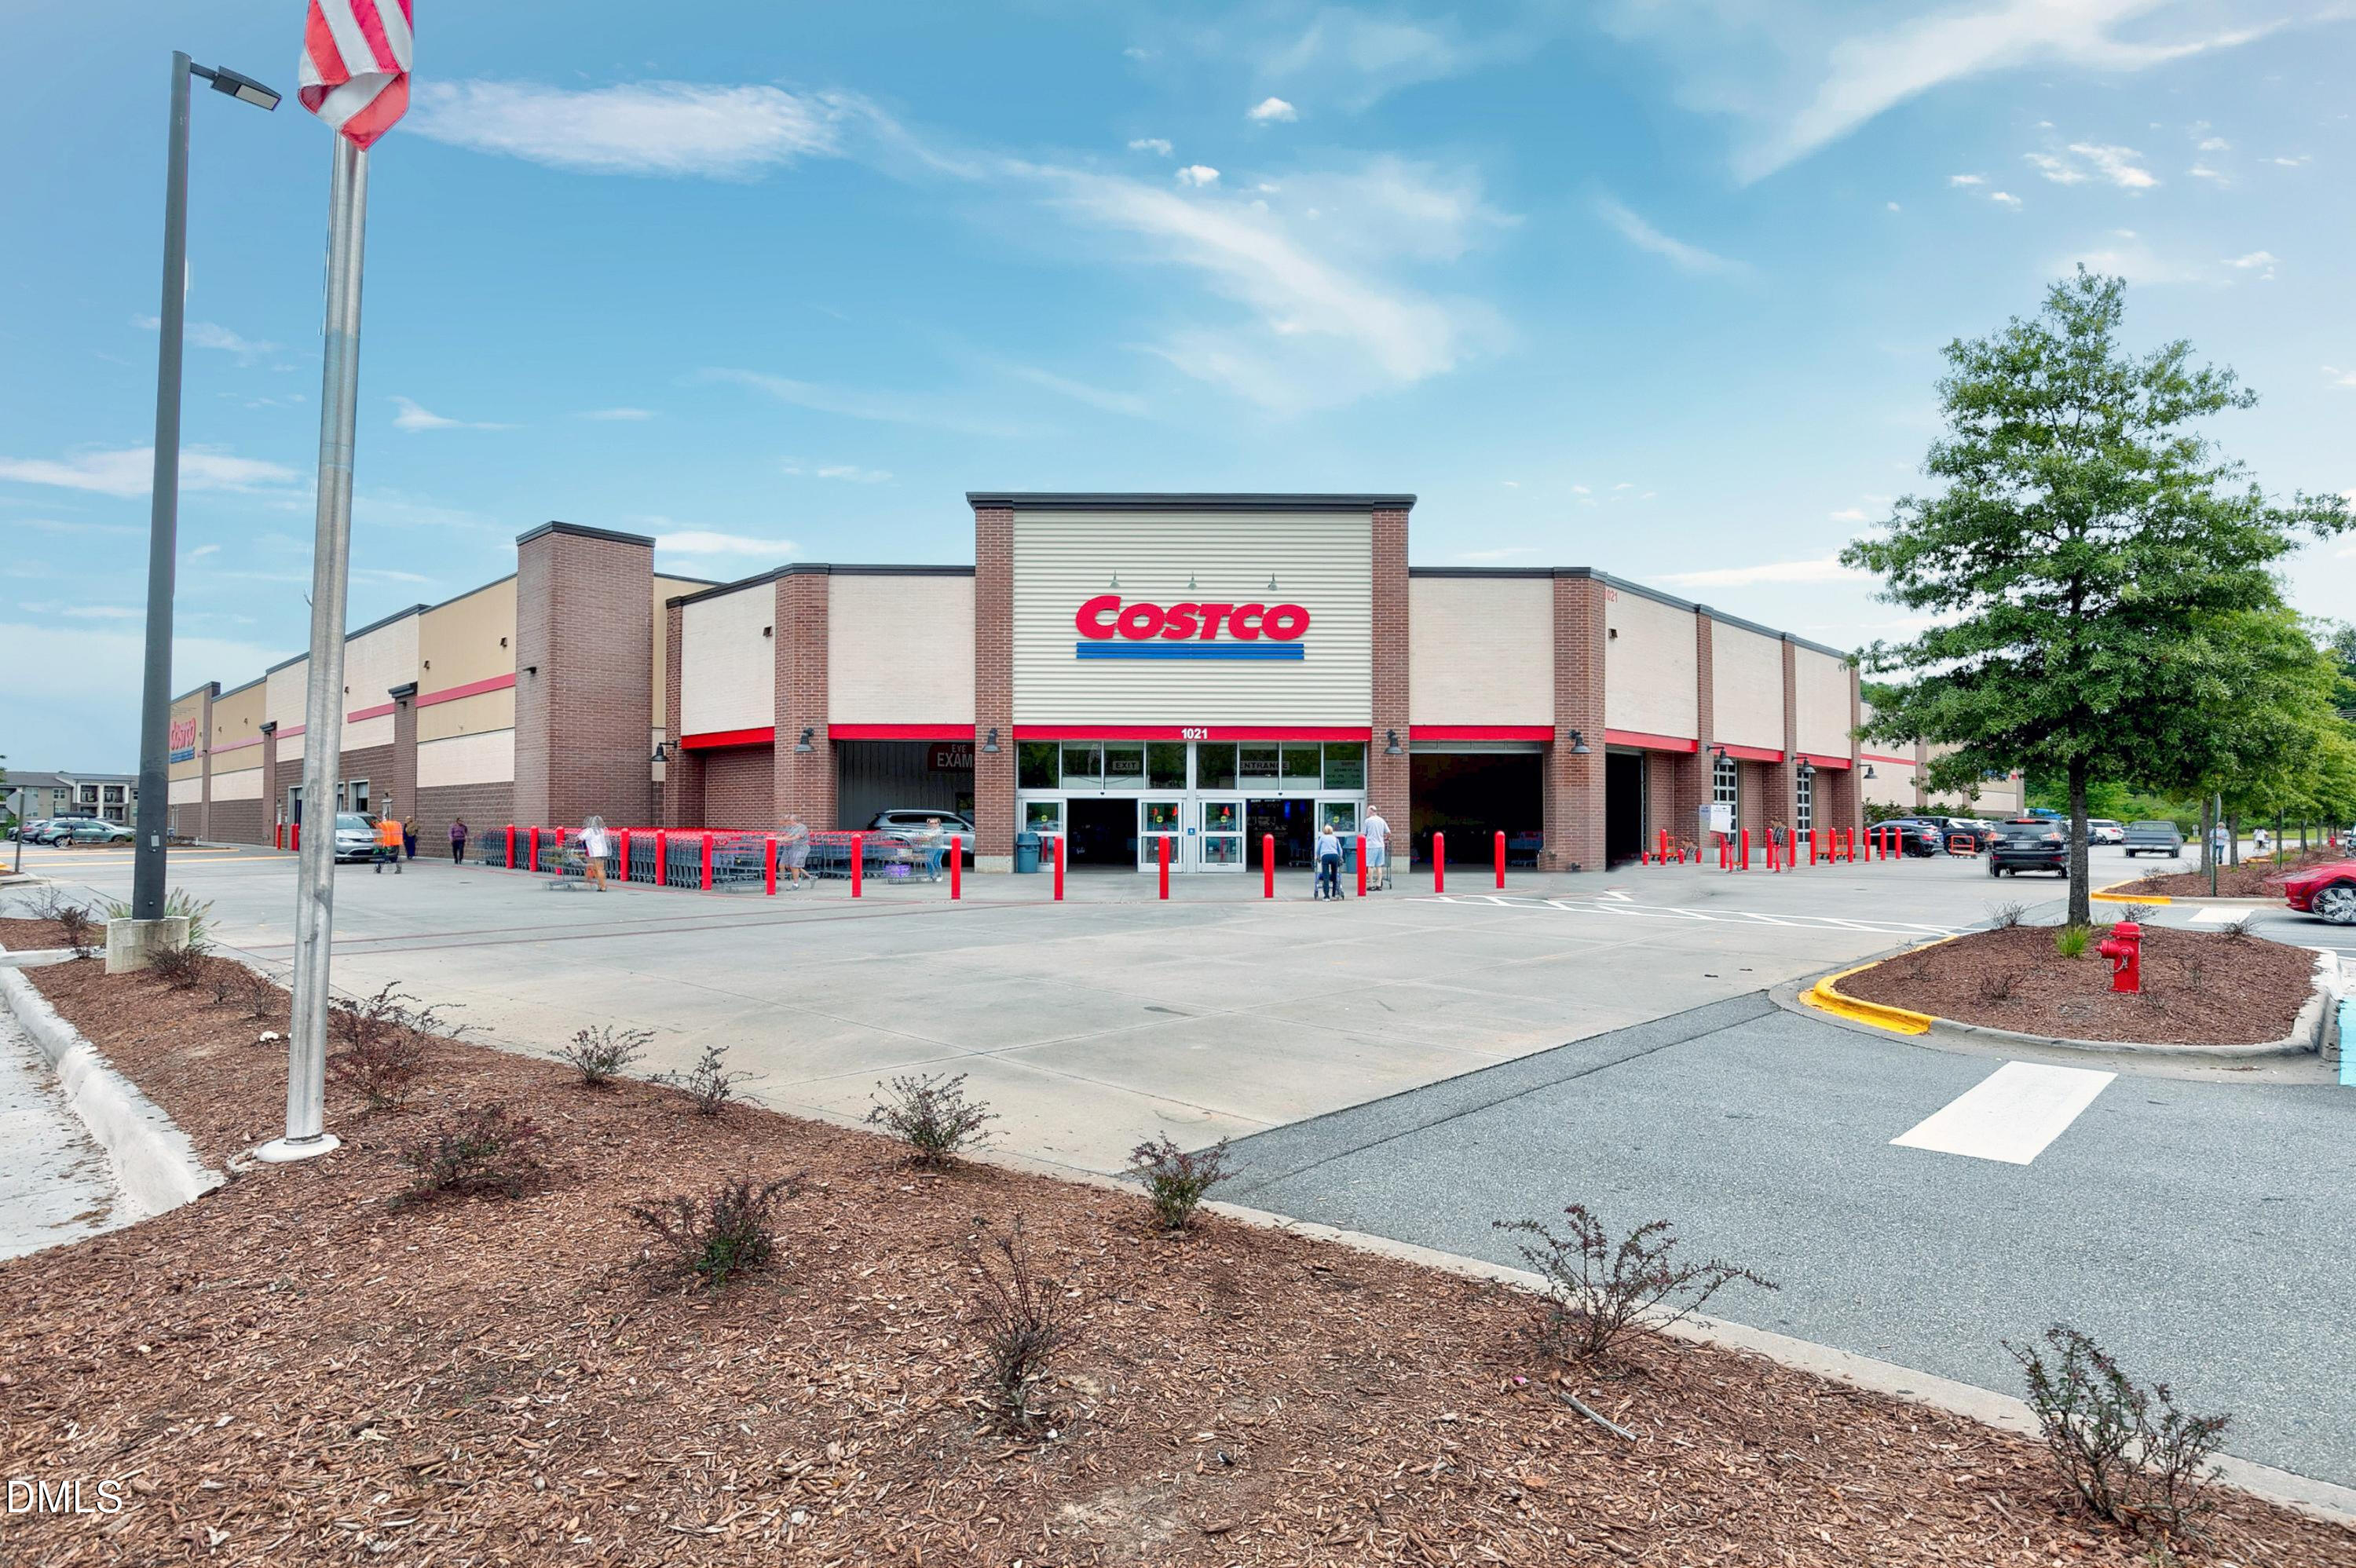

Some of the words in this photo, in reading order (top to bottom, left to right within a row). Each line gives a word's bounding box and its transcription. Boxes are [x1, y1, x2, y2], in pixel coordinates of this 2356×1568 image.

[1604, 589, 1618, 603] 021
[1076, 595, 1311, 641] COSTCO
[1181, 728, 1208, 740] 1021
[952, 744, 967, 753] EYE
[937, 752, 975, 768] EXAM
